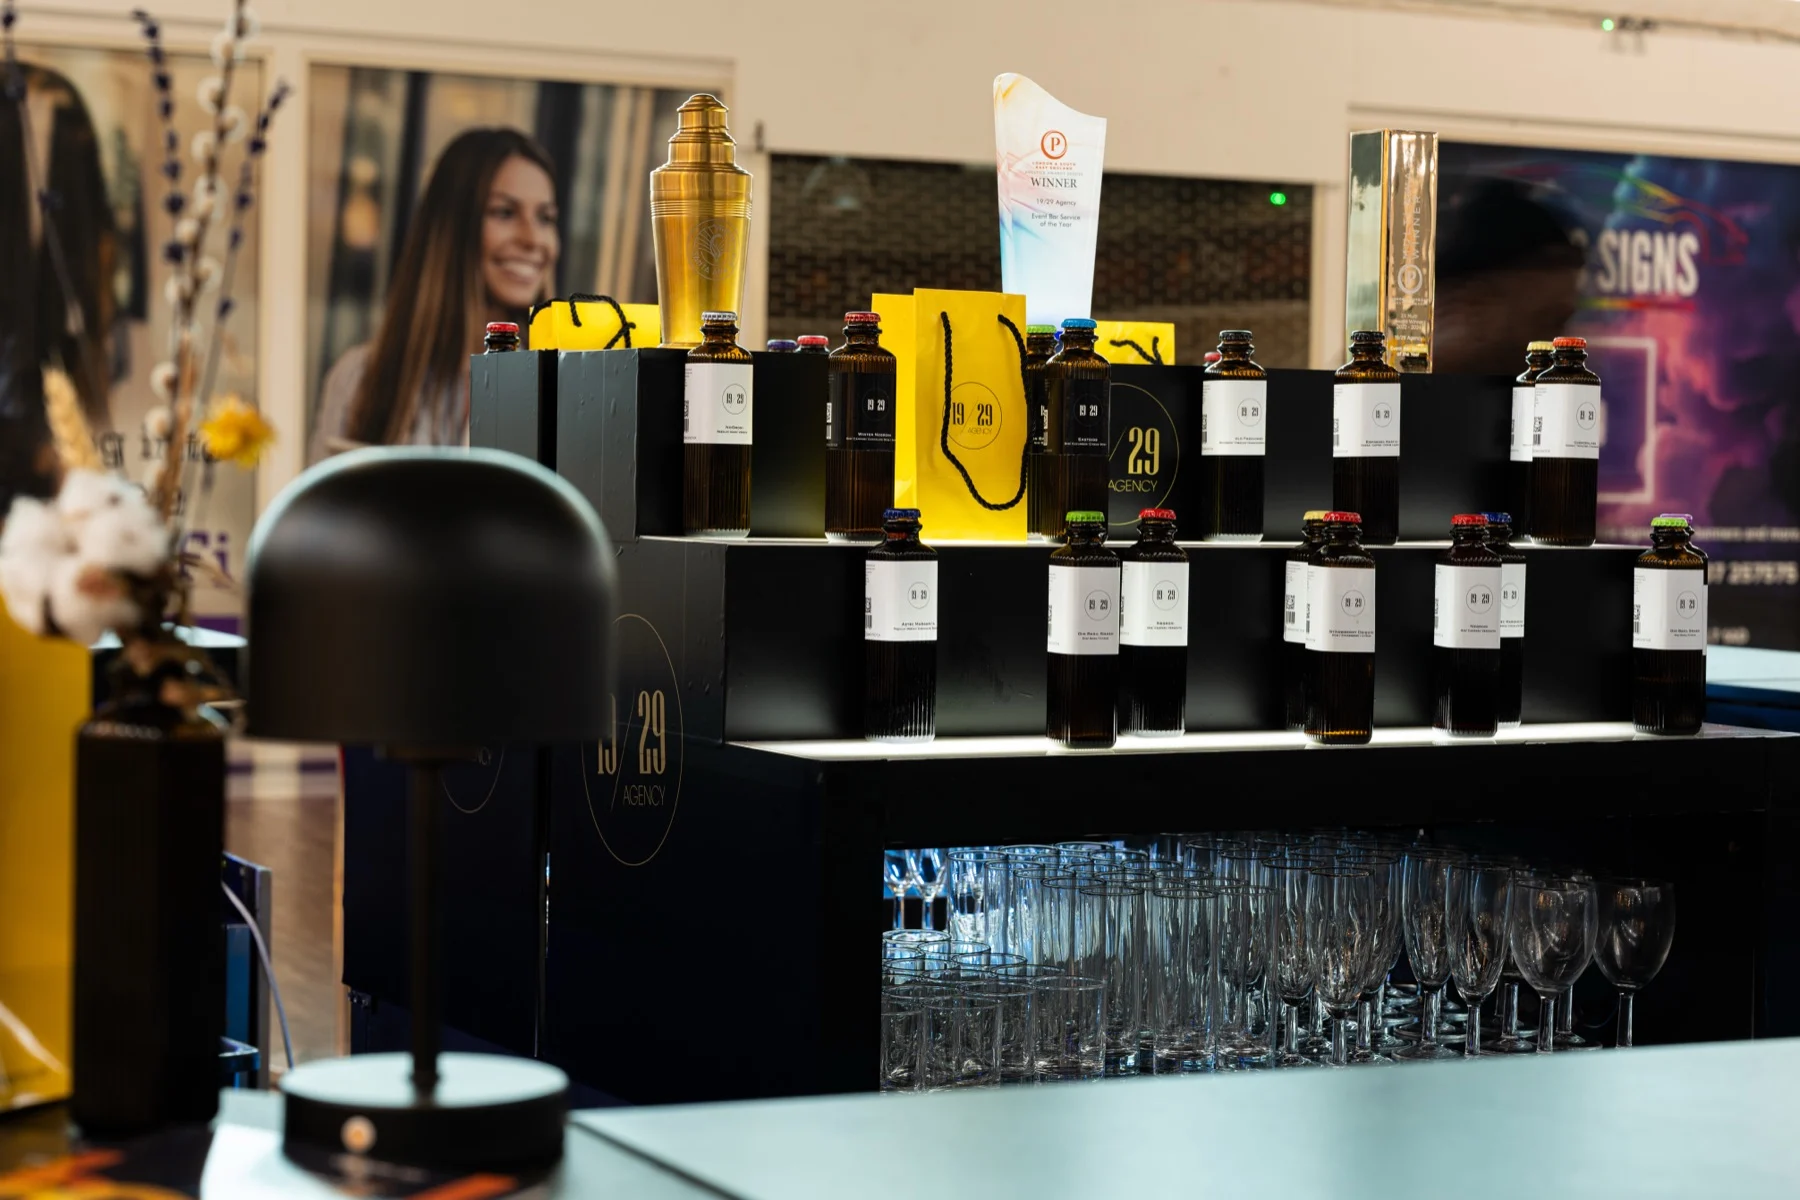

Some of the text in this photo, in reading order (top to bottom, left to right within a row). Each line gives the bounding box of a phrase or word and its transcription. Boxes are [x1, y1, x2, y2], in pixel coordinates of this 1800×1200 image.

[1031, 177, 1078, 188] WINNER
[1055, 199, 1077, 207] Agency
[1031, 212, 1048, 220] Event
[1060, 213, 1081, 221] Service
[1412, 195, 1421, 260] WINNER
[1598, 228, 1699, 297] SIGNS
[952, 402, 993, 426] 19 29
[1128, 427, 1160, 475] 29
[1108, 479, 1158, 492] AGENCY
[638, 690, 666, 775] 29
[623, 785, 666, 806] AGENCY
